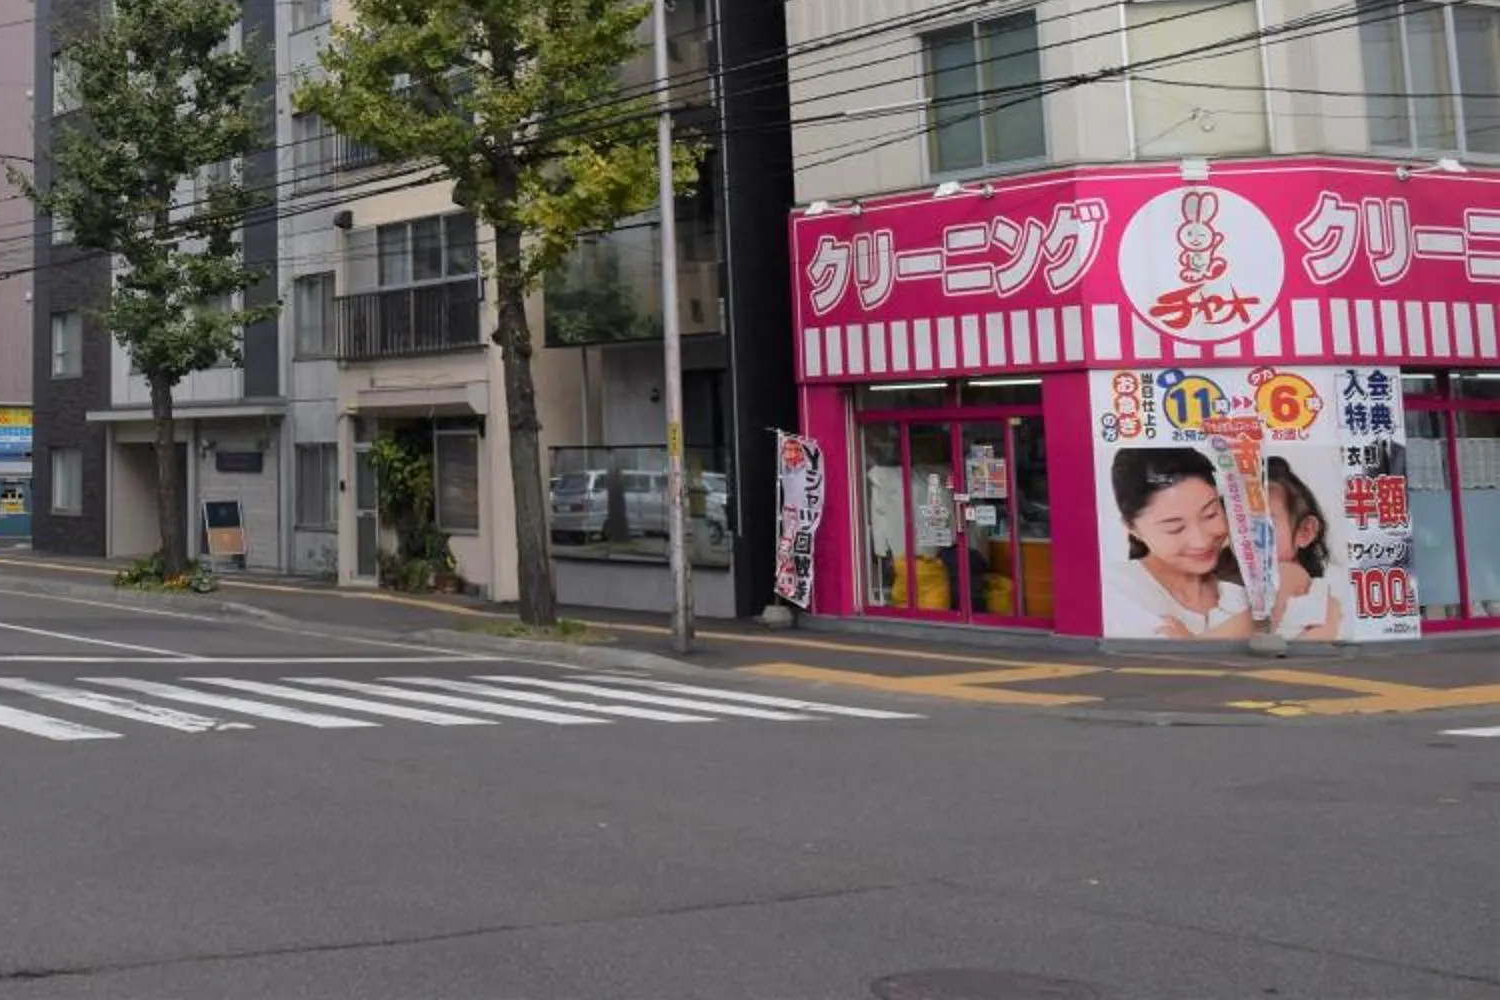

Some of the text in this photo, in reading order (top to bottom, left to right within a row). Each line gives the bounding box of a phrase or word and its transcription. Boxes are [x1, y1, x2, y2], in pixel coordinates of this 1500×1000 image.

[807, 198, 1109, 316] クリーニング
[1343, 369, 1393, 400] 入会
[1170, 388, 1211, 423] 11
[1271, 385, 1300, 422] 6
[1344, 402, 1396, 435] 特典
[1343, 474, 1409, 530] 半額
